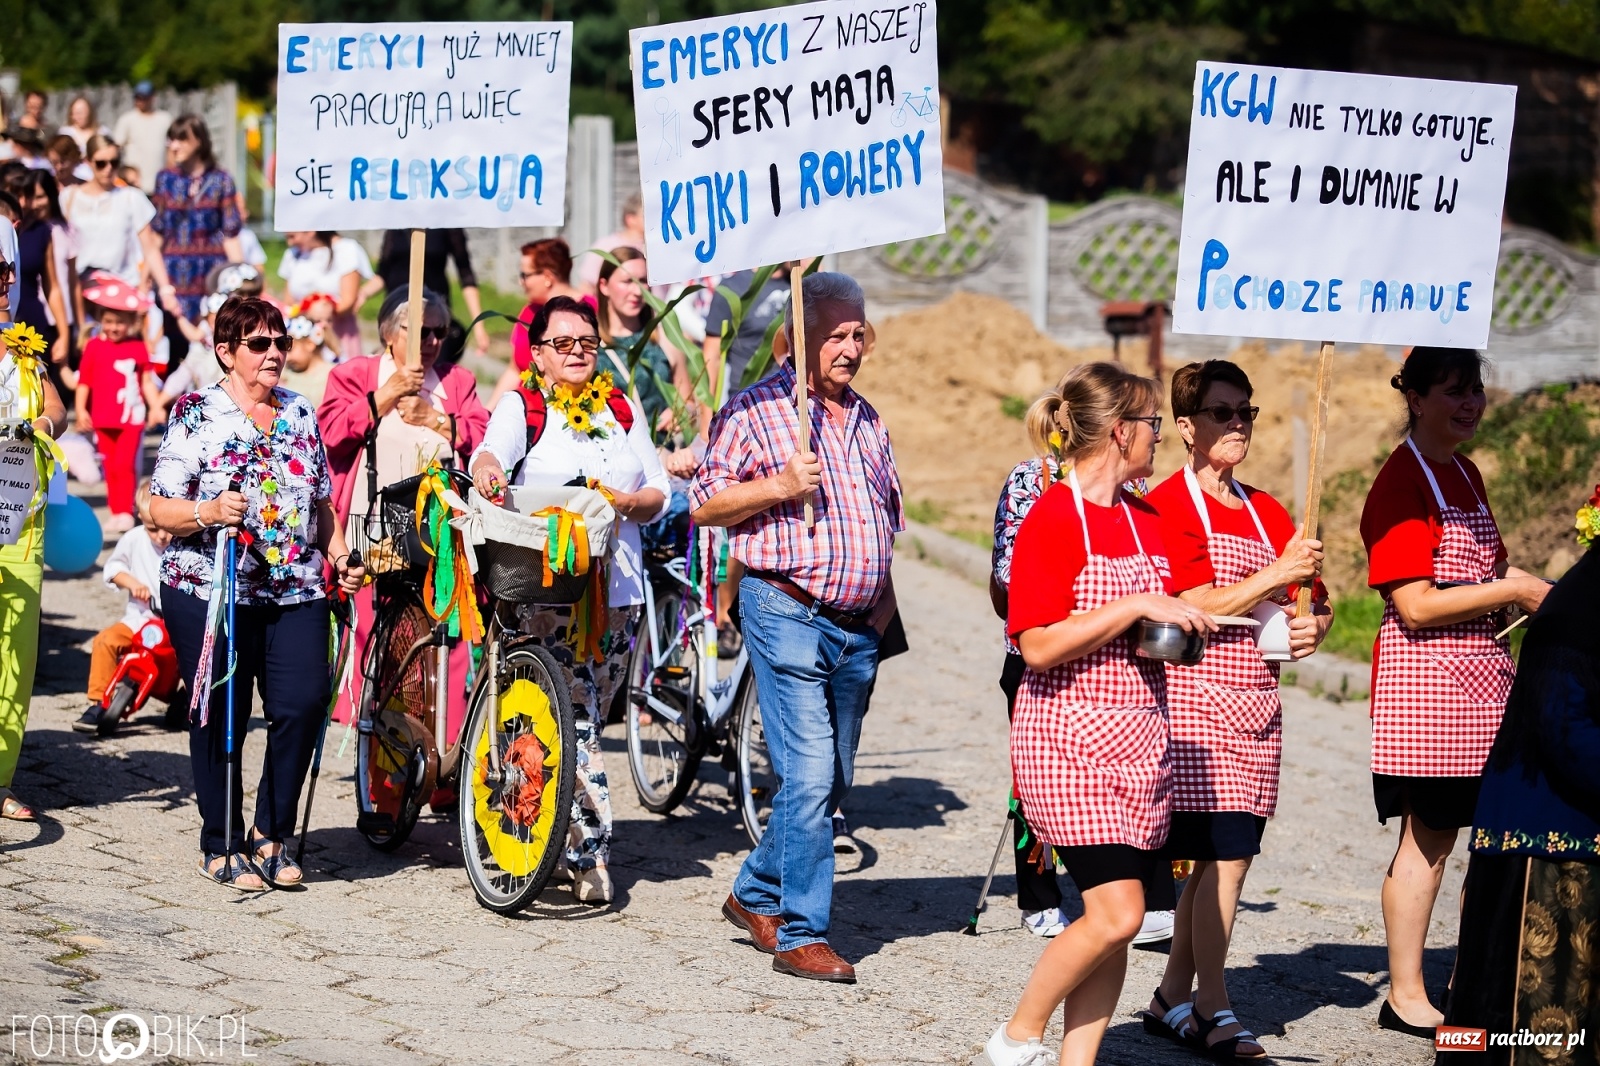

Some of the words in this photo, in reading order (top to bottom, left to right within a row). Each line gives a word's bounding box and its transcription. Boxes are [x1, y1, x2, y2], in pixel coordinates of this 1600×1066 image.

[286, 33, 425, 73] EMERYCI
[443, 30, 482, 79] JUŻ
[495, 30, 561, 73] MNIEJ
[640, 22, 789, 90] EMERYCI
[801, 14, 825, 54] Z
[836, 2, 927, 54] NASZEJ
[691, 84, 794, 149] SFERY
[810, 64, 896, 126] MAJĄ
[1200, 68, 1277, 125] KGW
[1289, 102, 1325, 130] NIE
[1339, 105, 1402, 136] TYLKO
[349, 154, 543, 213] RELAKSUJĄ
[660, 169, 749, 264] KIJKI
[769, 162, 782, 217] I
[799, 129, 925, 210] ROWERY
[1216, 160, 1272, 203] ALE
[1290, 164, 1302, 202] I
[1319, 165, 1423, 211] DUMNIE
[1434, 175, 1459, 214] W
[1197, 239, 1343, 312] POCHODZIE
[1357, 278, 1473, 325] PARADUJE
[2, 456, 24, 465] DUŻO
[6, 446, 31, 454] CZASU
[9, 480, 30, 490] MAŁO
